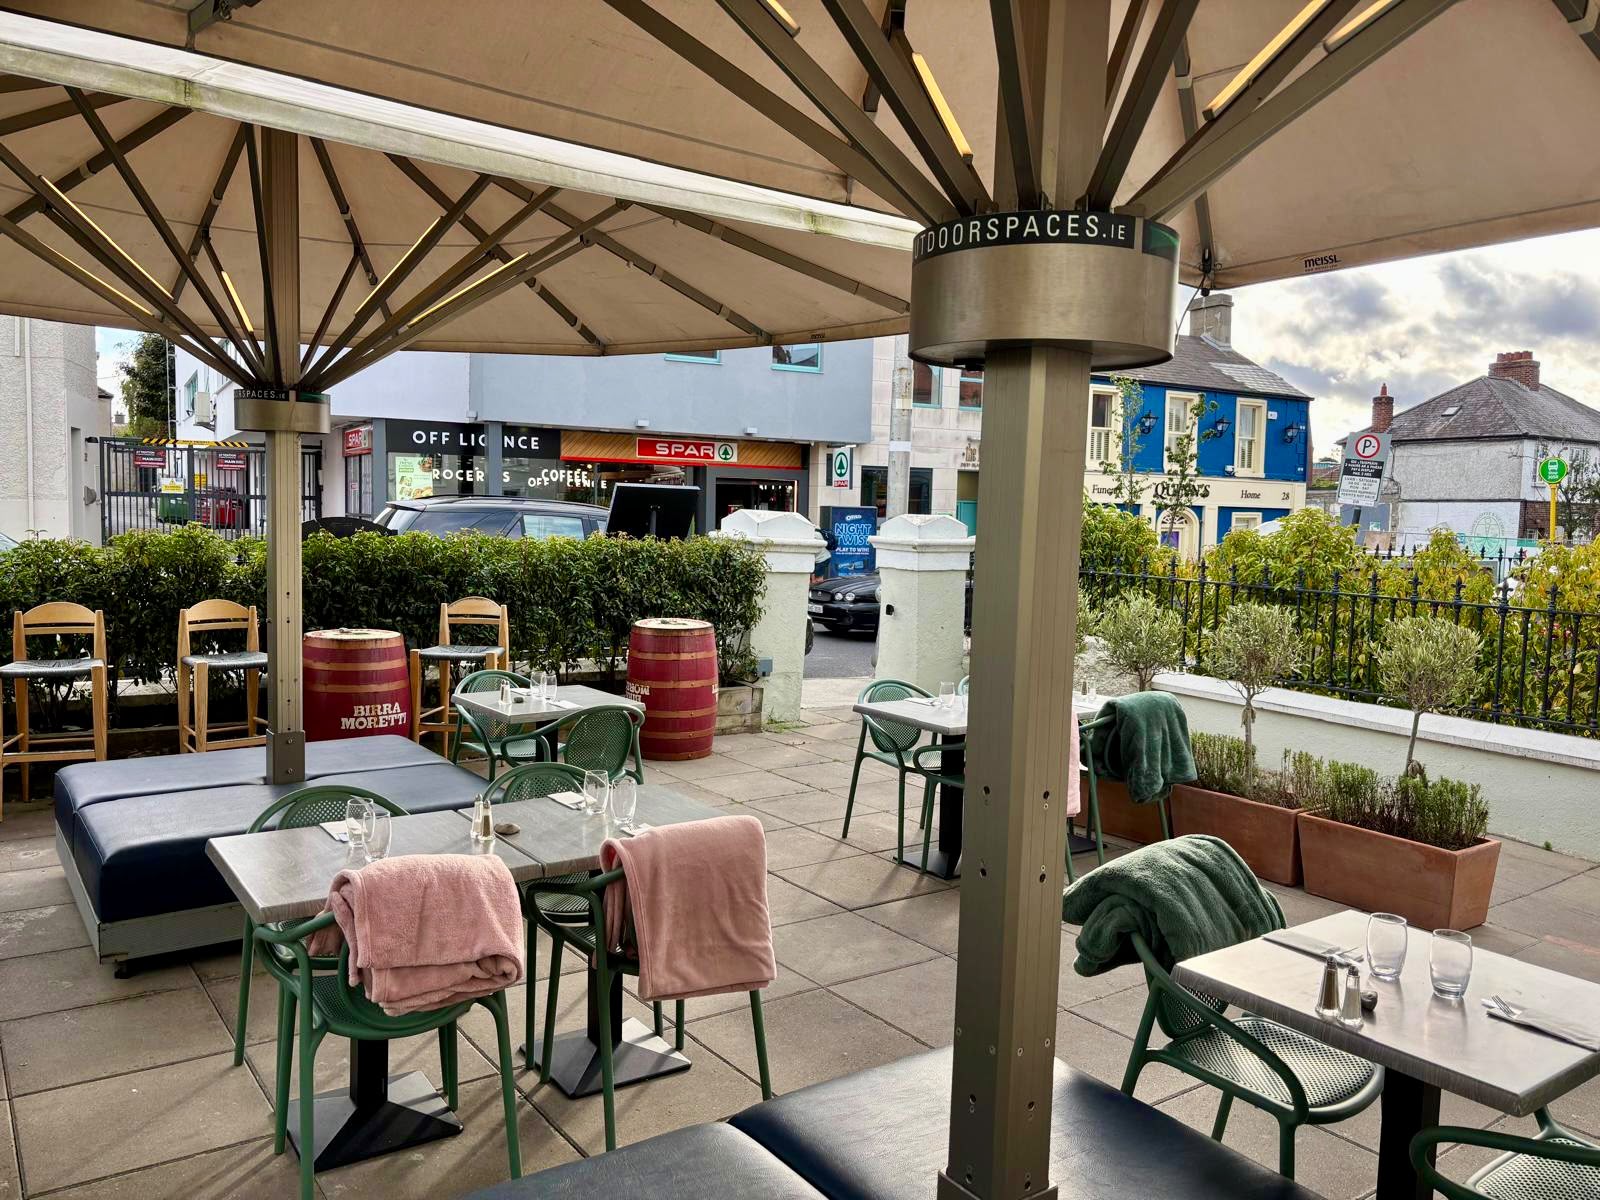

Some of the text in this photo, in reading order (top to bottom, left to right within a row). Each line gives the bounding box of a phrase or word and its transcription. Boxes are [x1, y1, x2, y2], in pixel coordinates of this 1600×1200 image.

[348, 432, 362, 447] SPAR
[412, 430, 540, 450] OFF LICNCE
[655, 442, 714, 457] SPAR
[1240, 490, 1261, 499] Home
[1281, 491, 1290, 501] 28
[834, 523, 872, 536] NIGHT
[353, 702, 401, 717] BIRRA
[340, 712, 406, 730] MORETTI
